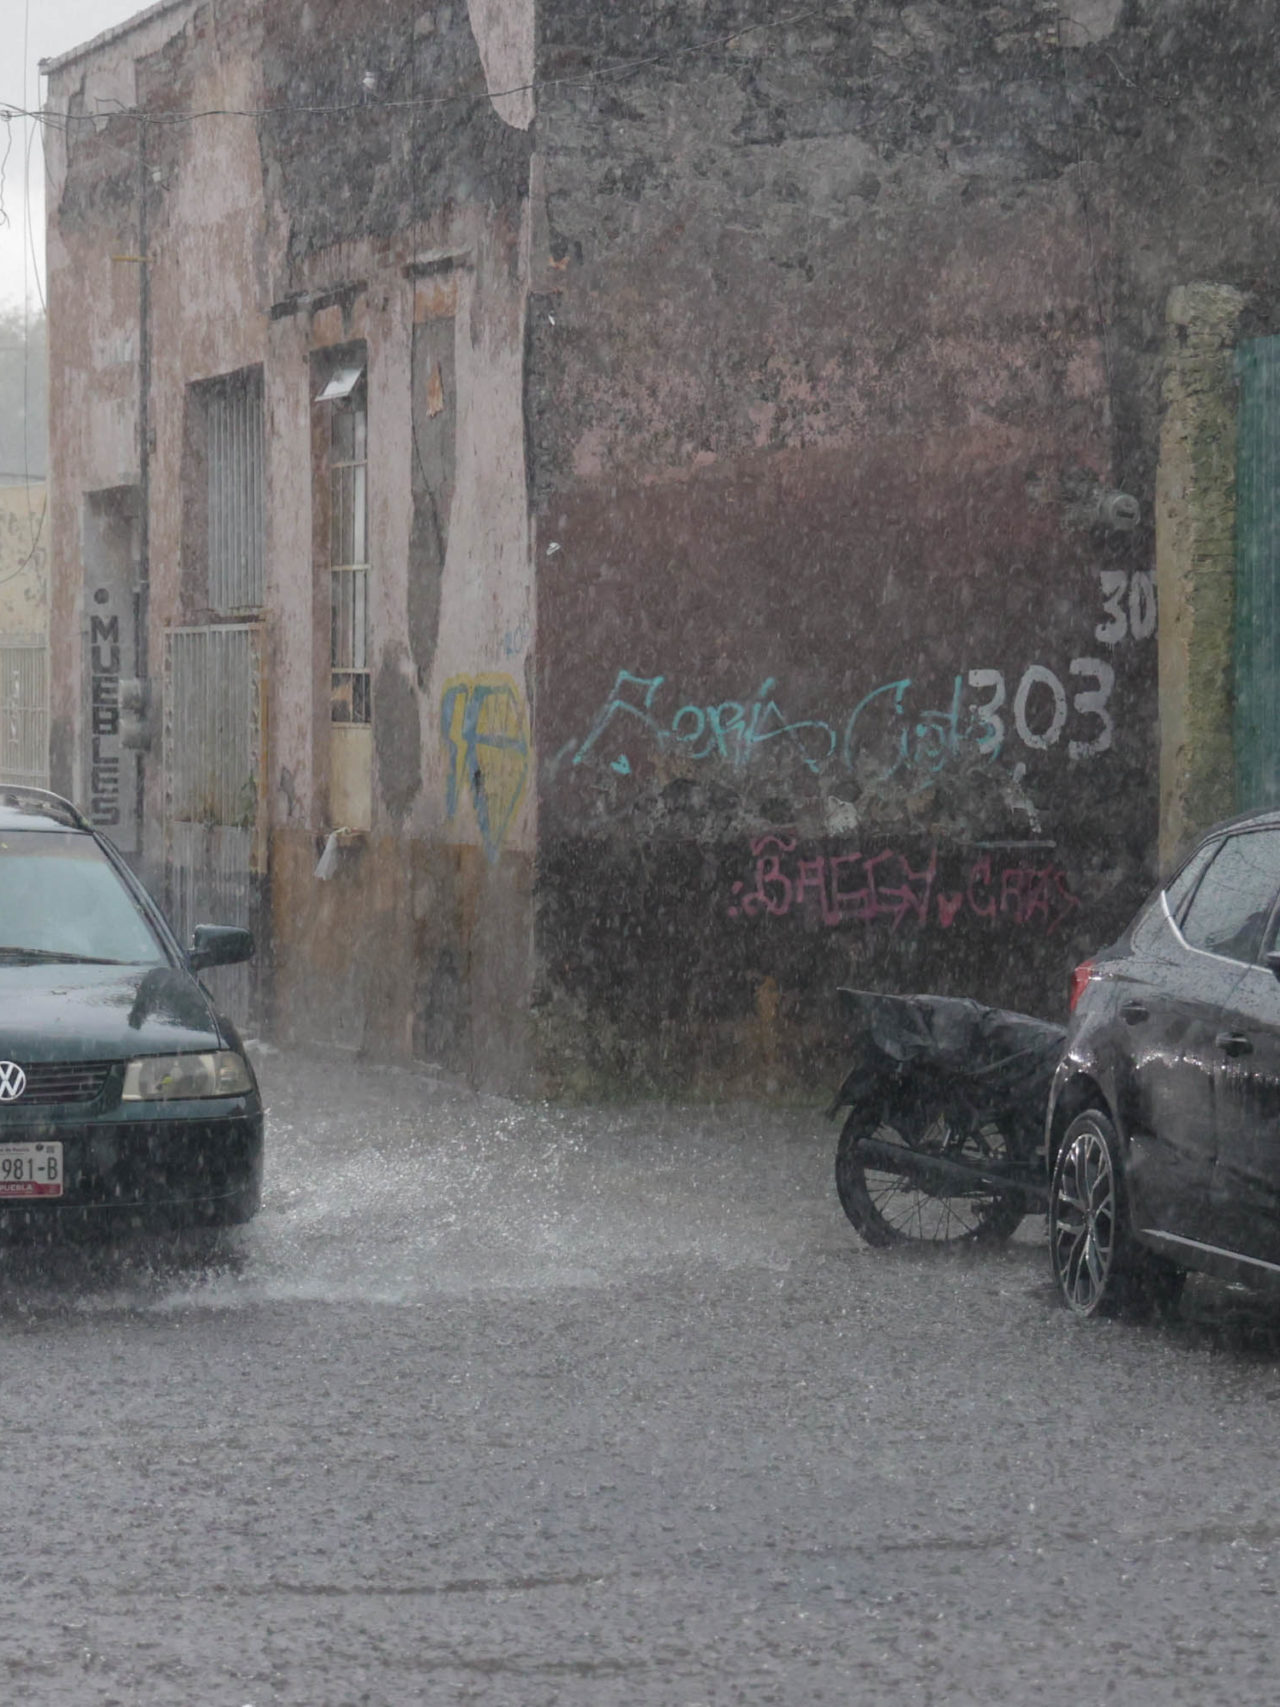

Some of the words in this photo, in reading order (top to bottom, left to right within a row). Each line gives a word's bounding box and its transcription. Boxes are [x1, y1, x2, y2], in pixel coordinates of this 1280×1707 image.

[1095, 570, 1158, 643] 30
[90, 615, 119, 826] MUEBLES
[968, 657, 1115, 760] 303
